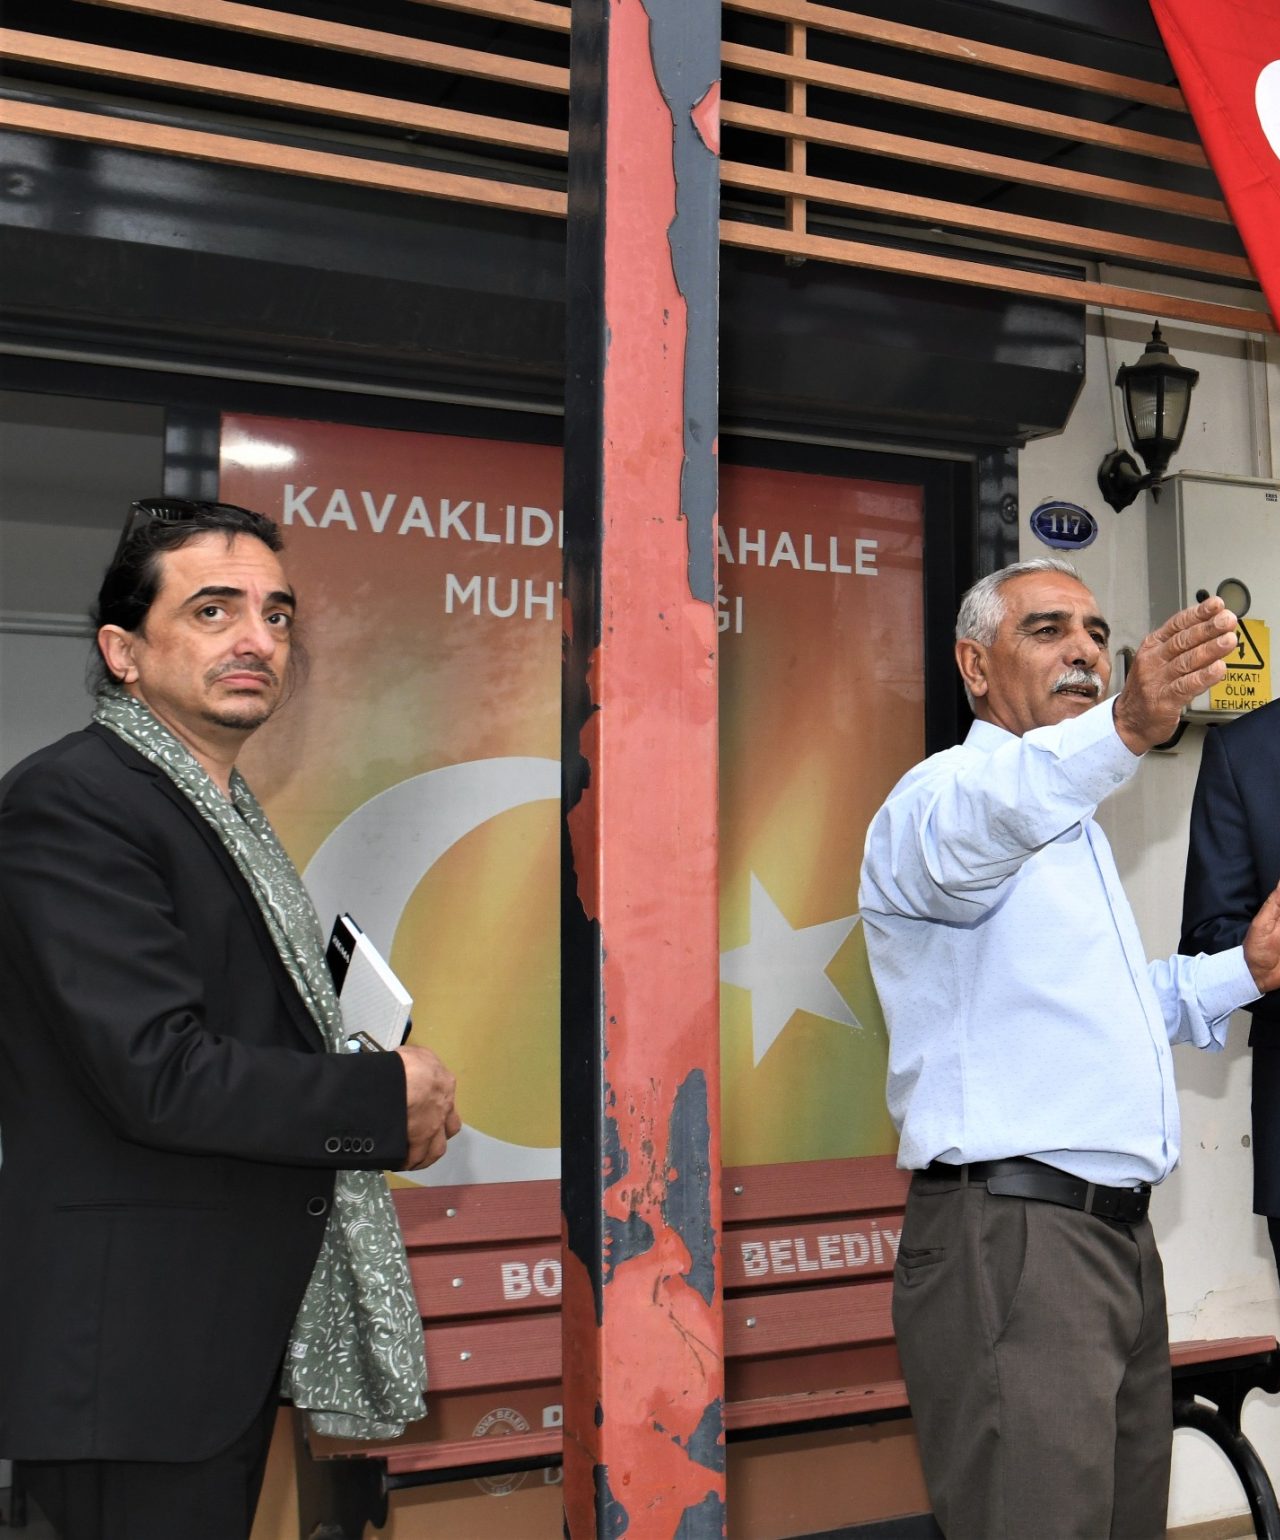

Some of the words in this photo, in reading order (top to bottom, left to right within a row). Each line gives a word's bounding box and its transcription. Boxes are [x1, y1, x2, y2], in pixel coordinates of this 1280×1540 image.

[282, 484, 563, 549] KAVAKLID
[718, 525, 878, 576] AHALLE
[1050, 513, 1081, 535] 117
[1225, 684, 1256, 696] ÖLÜM
[502, 1258, 562, 1301] BO
[741, 1221, 902, 1277] BELEDİY
